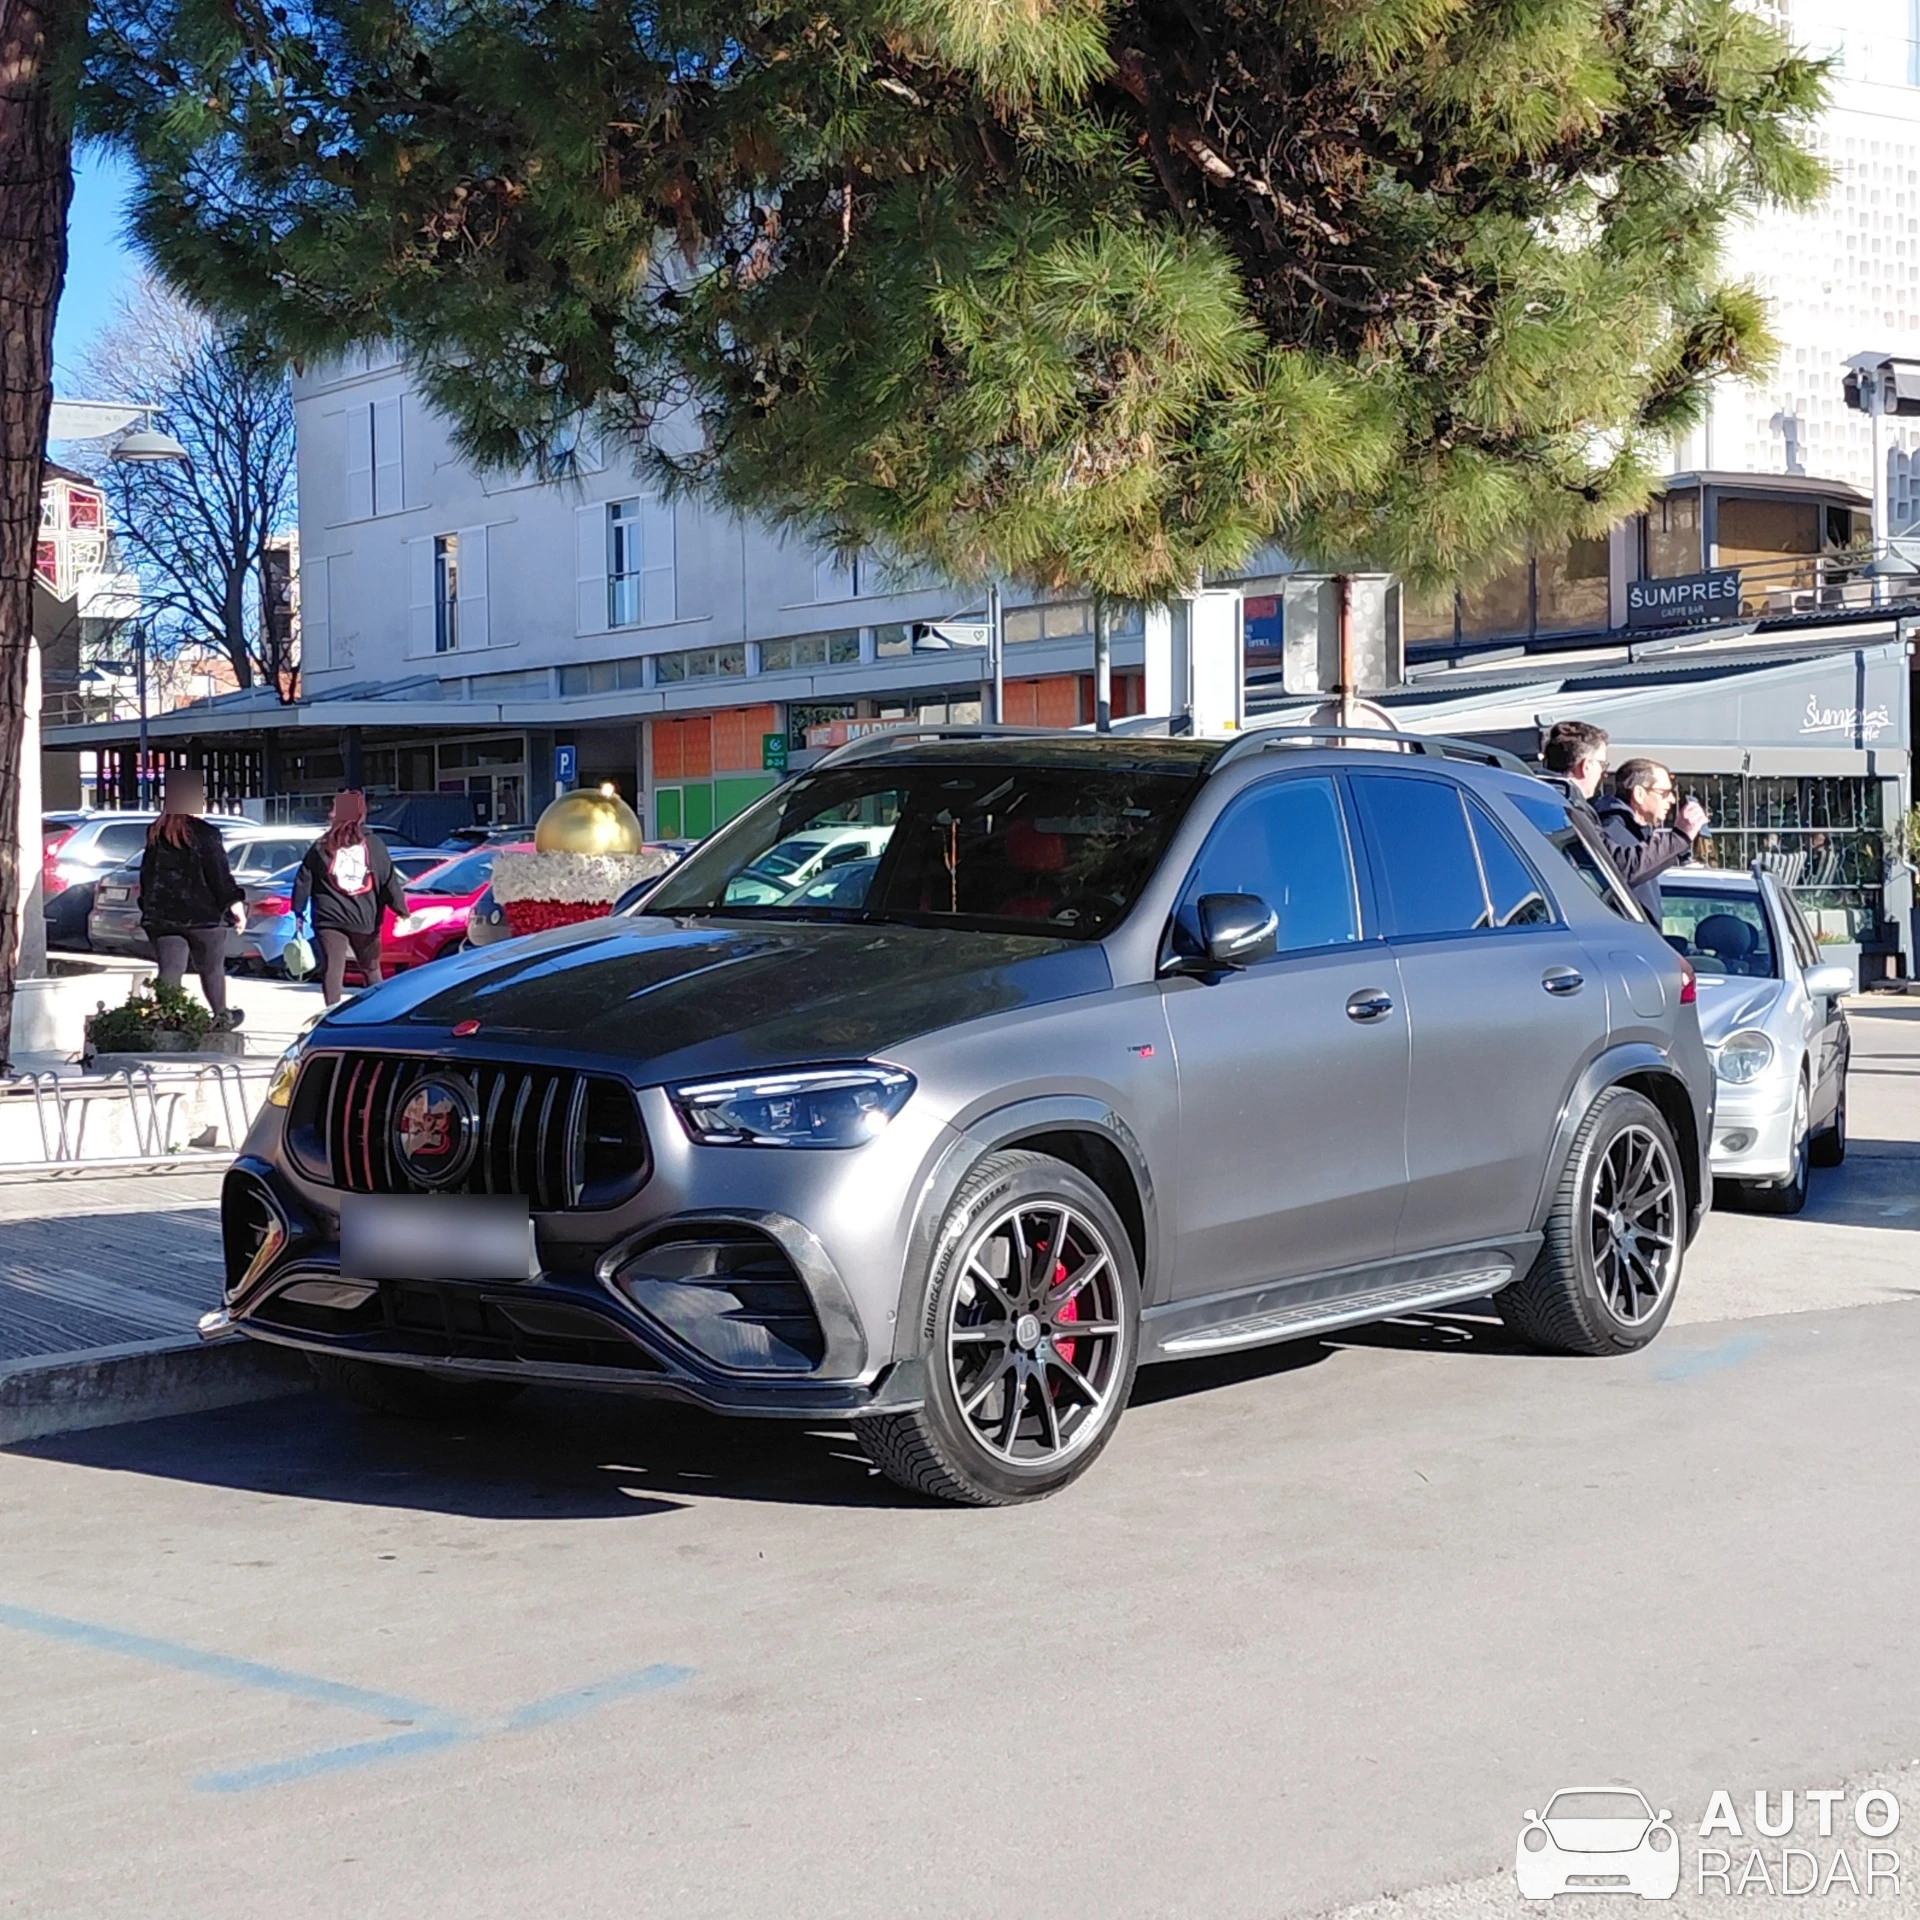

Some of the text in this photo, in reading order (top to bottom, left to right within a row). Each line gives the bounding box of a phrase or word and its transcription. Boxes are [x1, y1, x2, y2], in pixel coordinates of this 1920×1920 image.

[1630, 576, 1736, 608] ŠUMPREŠ
[1661, 605, 1704, 618] CAFFE BAR
[560, 752, 570, 775] P
